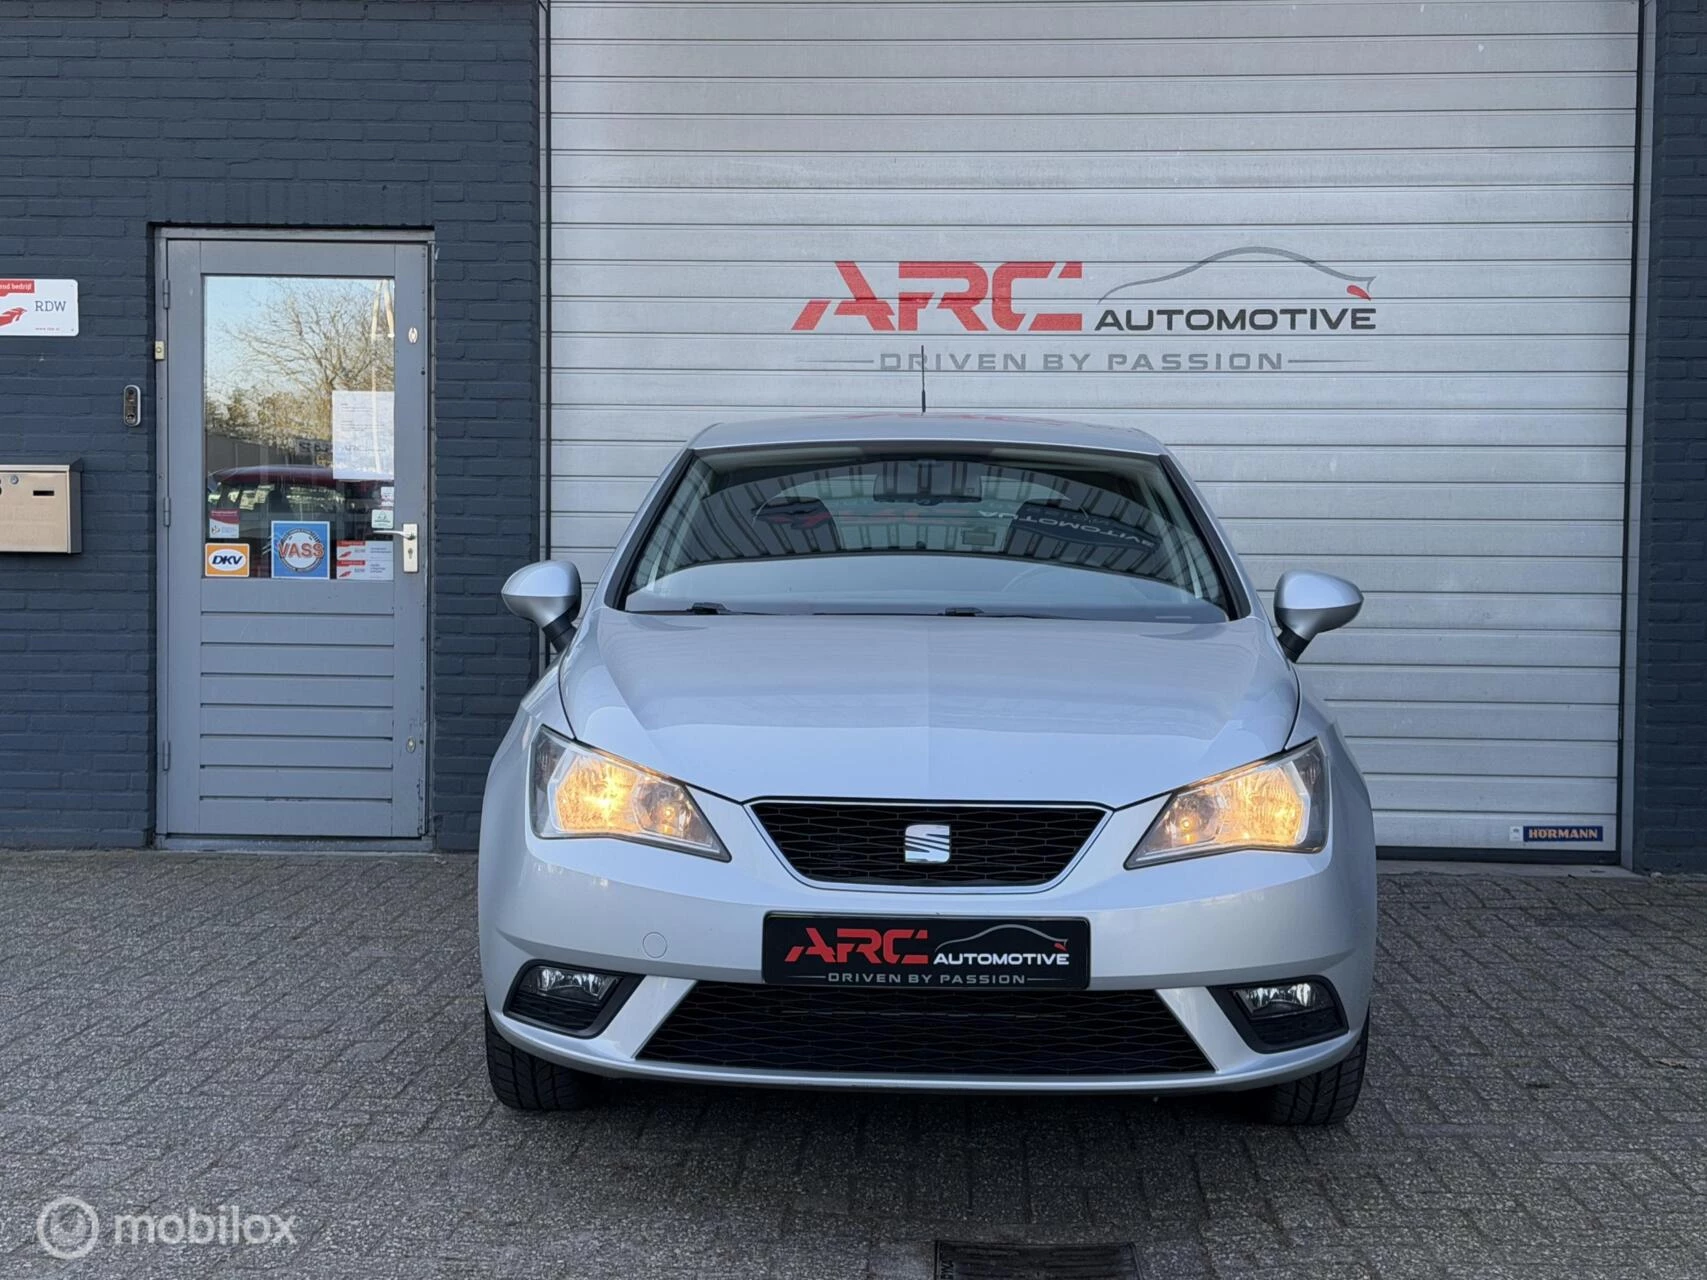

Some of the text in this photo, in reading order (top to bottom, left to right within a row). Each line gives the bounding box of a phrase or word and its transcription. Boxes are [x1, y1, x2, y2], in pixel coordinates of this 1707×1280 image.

[791, 260, 1378, 331] ARC AUTOMOTIVE
[35, 300, 66, 312] RDW
[879, 353, 1285, 371] DRIVEN BY PASSION
[278, 542, 324, 558] VASS
[212, 555, 243, 565] DKV
[784, 927, 1070, 965] ARC AUTOMOTIVE
[828, 972, 1026, 985] DRIVEN BY PASSION
